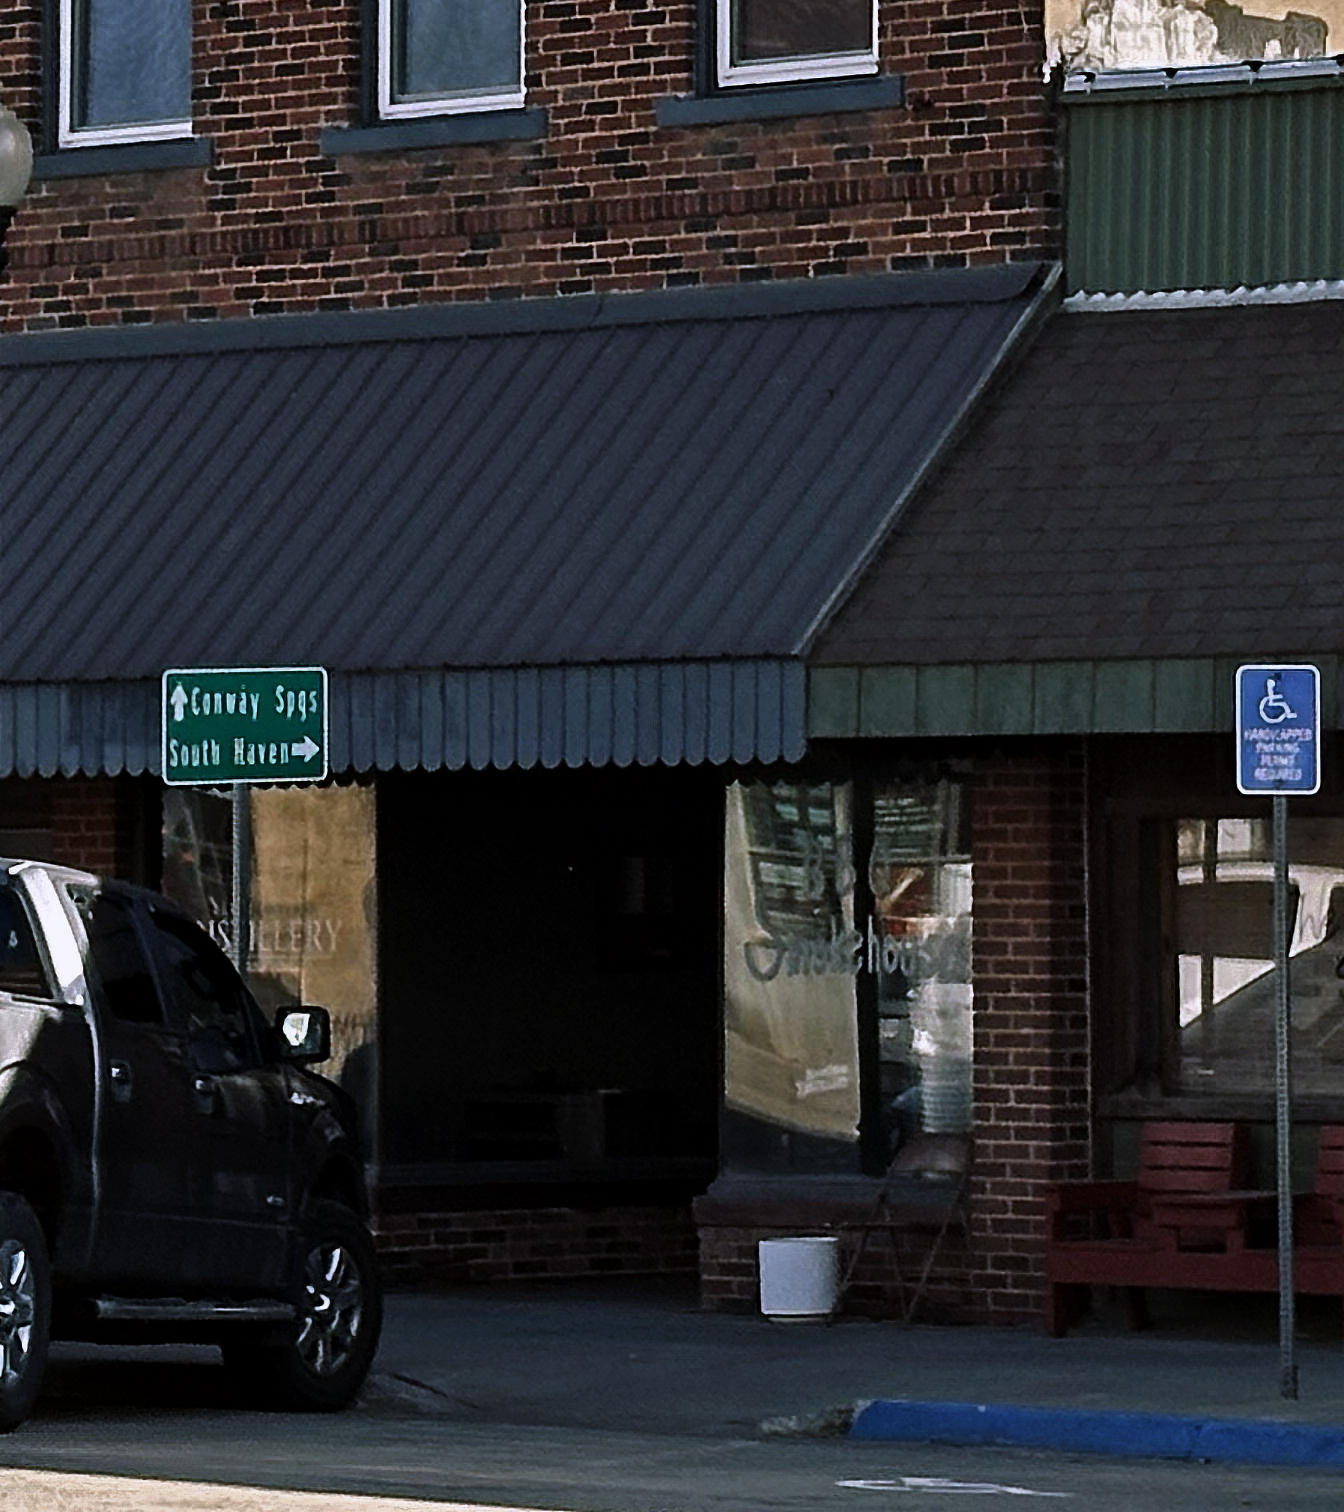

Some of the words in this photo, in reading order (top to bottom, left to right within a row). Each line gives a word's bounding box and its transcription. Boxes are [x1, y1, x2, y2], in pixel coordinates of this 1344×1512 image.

[191, 685, 260, 721] Conway
[275, 684, 317, 722] Spgs
[169, 738, 220, 767] South
[234, 737, 289, 765] Haven
